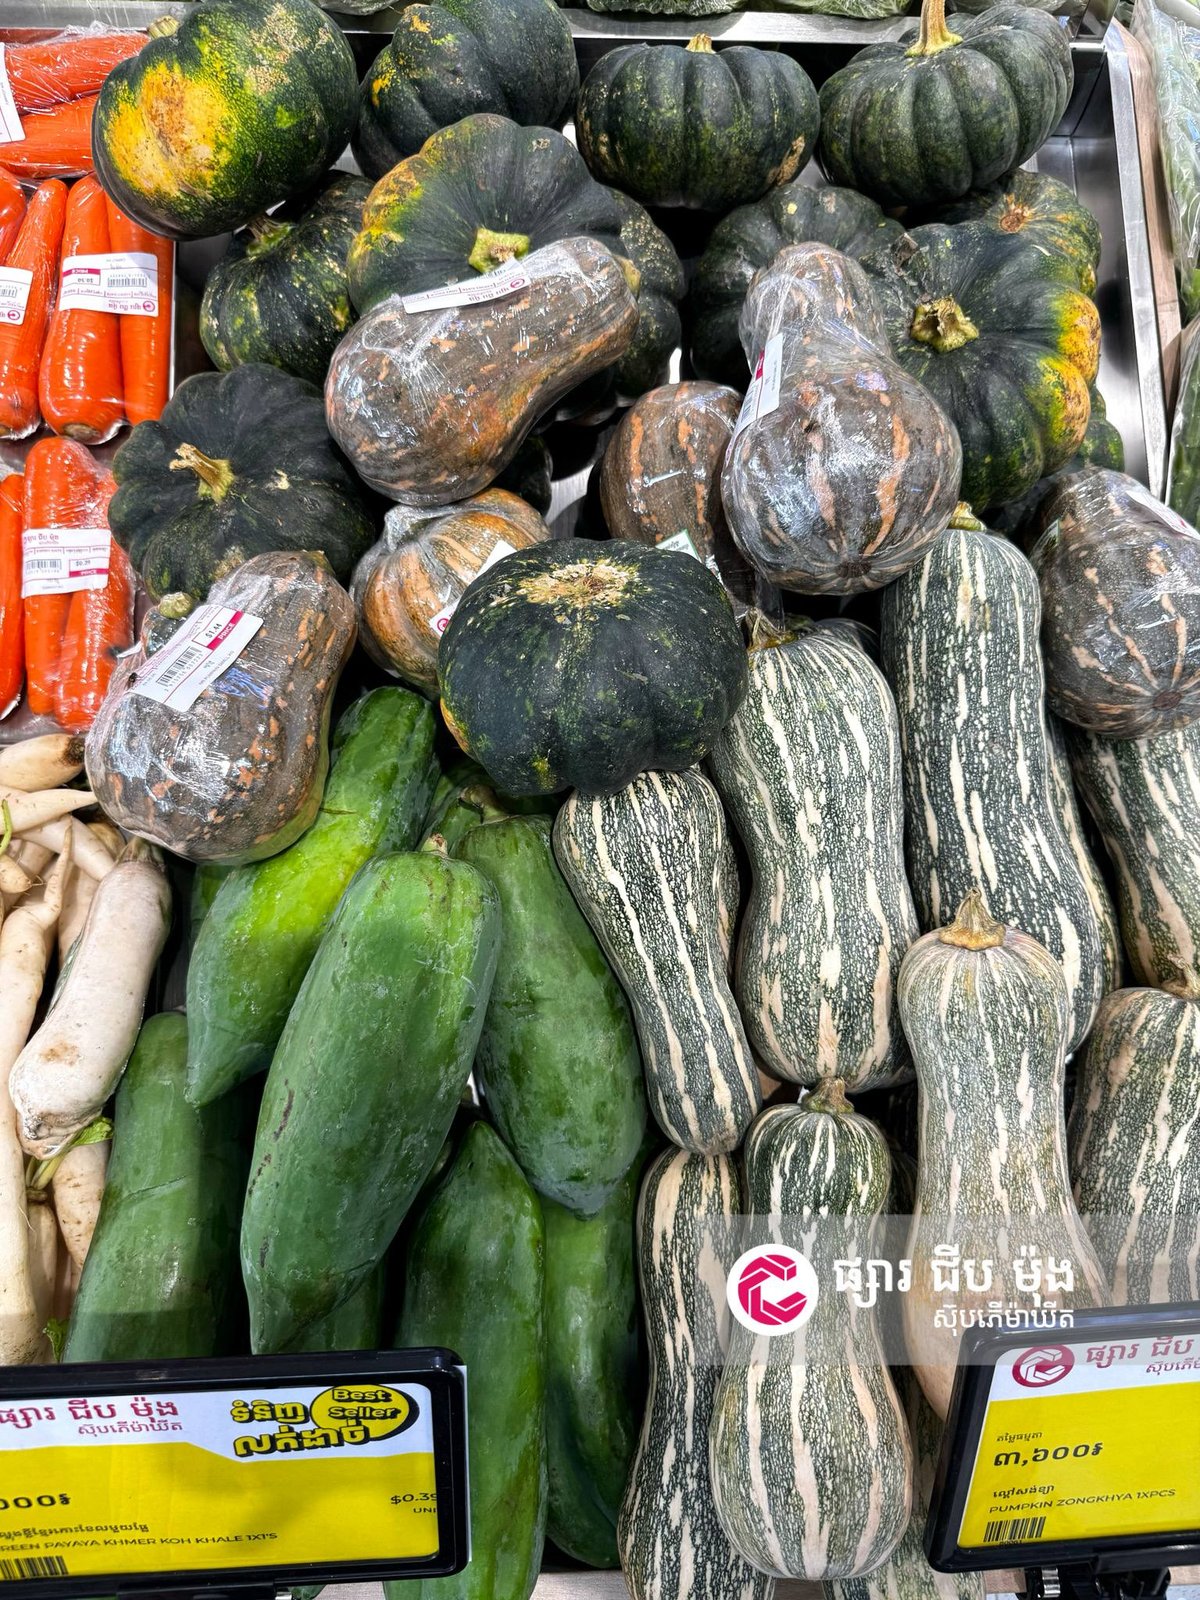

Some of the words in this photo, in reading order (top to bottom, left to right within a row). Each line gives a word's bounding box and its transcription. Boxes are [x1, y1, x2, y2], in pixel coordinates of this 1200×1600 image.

[217, 622, 236, 640] PRICE
[1086, 1343, 1140, 1369] ផ្សារ
[1151, 1335, 1194, 1357] ជីប
[332, 1388, 392, 1403] Best
[68, 1399, 117, 1420] ជីប
[130, 1397, 178, 1422] ម៉ុង
[230, 1399, 310, 1424] ទំនិញ
[328, 1406, 402, 1421] Seller
[233, 1418, 370, 1457] លក់ដាច់
[989, 1500, 1053, 1514] PUMPKIN
[1056, 1493, 1133, 1507] ZONGKHYA
[1136, 1488, 1176, 1499] 1XPCS
[44, 1540, 101, 1549] PAYAYA
[104, 1537, 156, 1546] KHMER
[195, 1535, 243, 1544] KHALE
